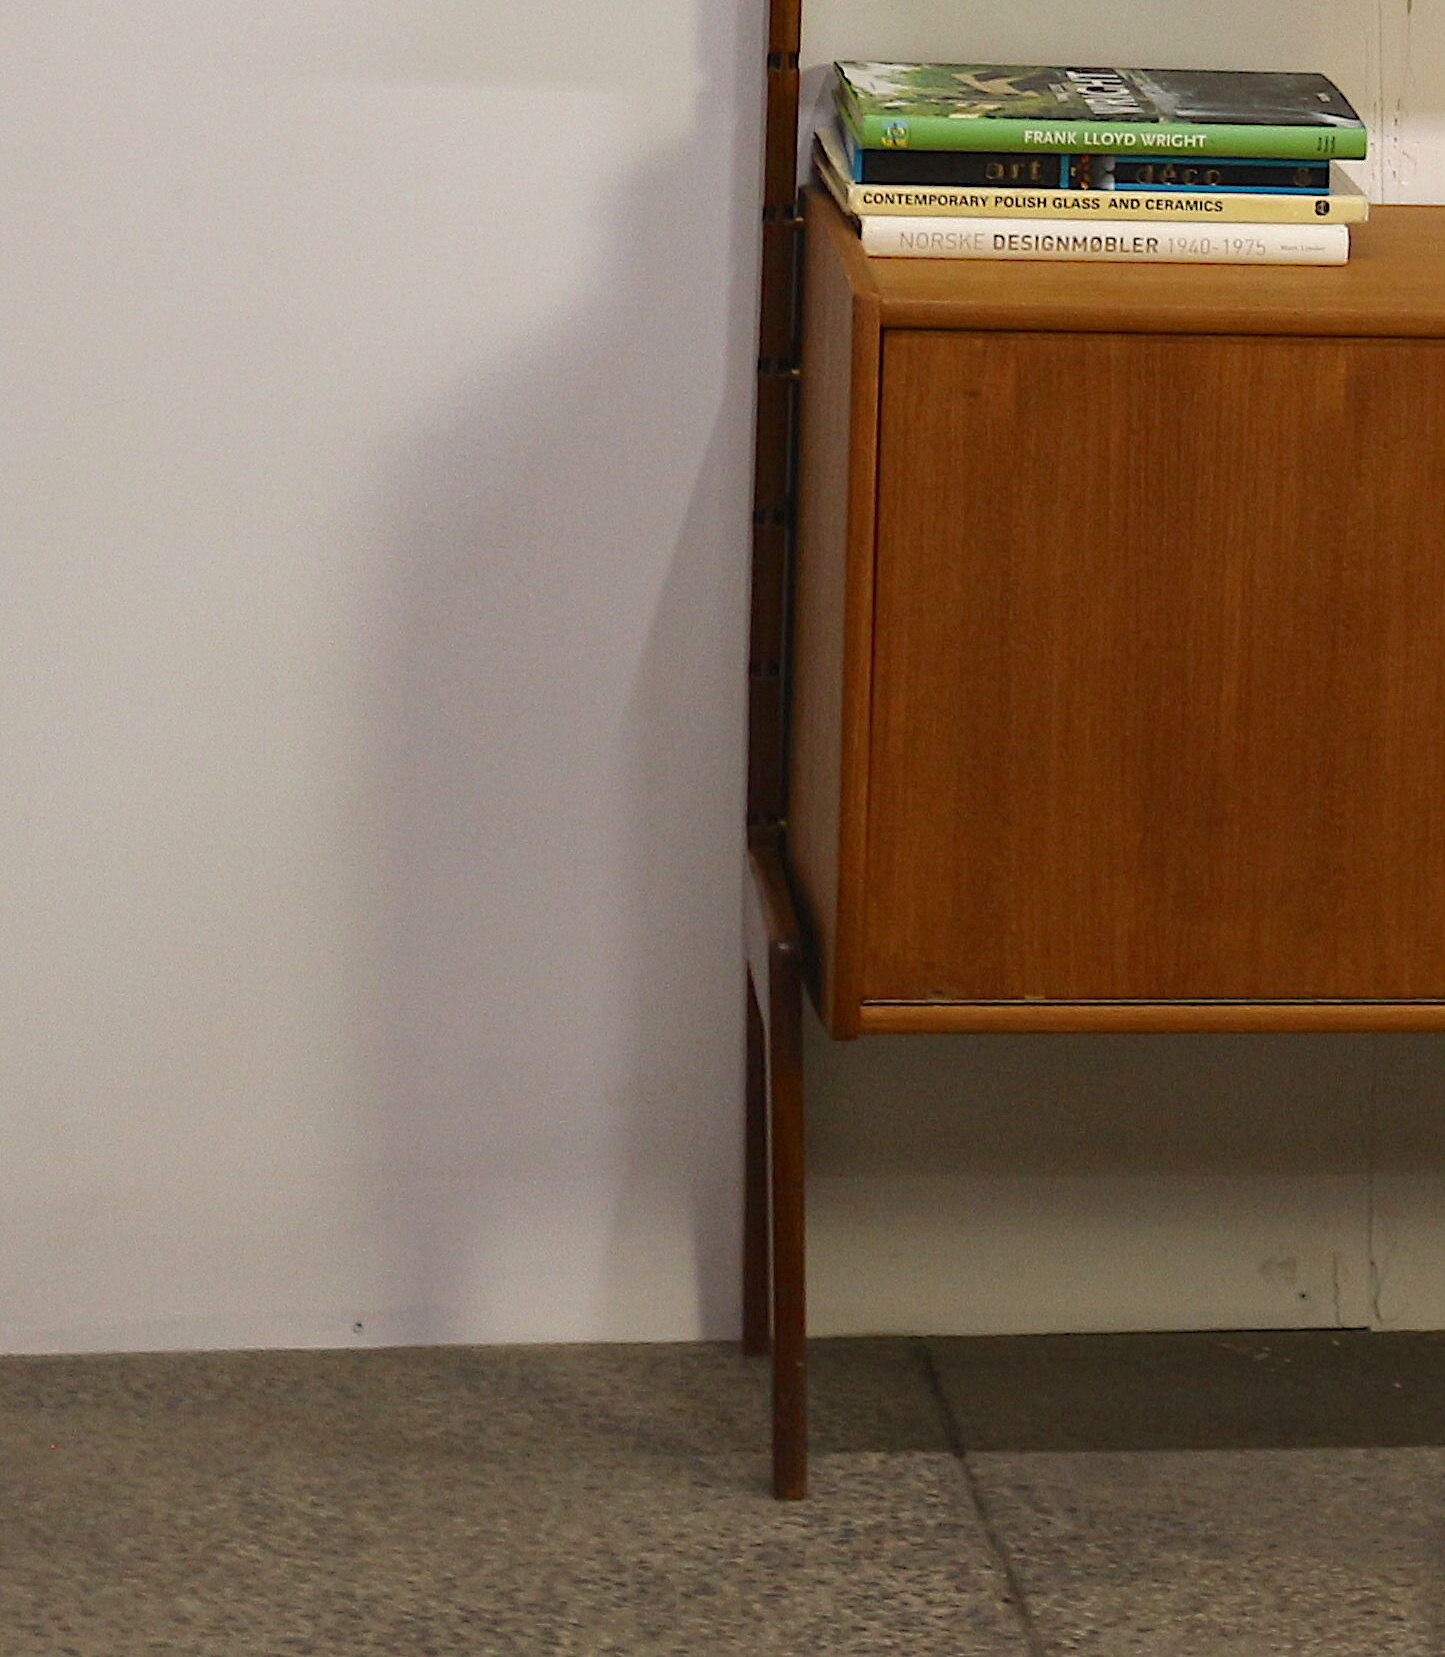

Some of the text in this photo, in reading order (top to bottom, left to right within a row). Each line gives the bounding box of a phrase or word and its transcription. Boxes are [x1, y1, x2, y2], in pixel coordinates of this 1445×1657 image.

[1066, 70, 1144, 114] WRIGHT
[1023, 130, 1208, 148] FRANK LLOYD WRIGHT
[985, 160, 1042, 180] art
[862, 192, 1224, 213] CONTEMPORARY POLISH GLASS AND CERAMICS
[900, 231, 1267, 256] NORSKE DESIGNMØBLER 1940-1975
